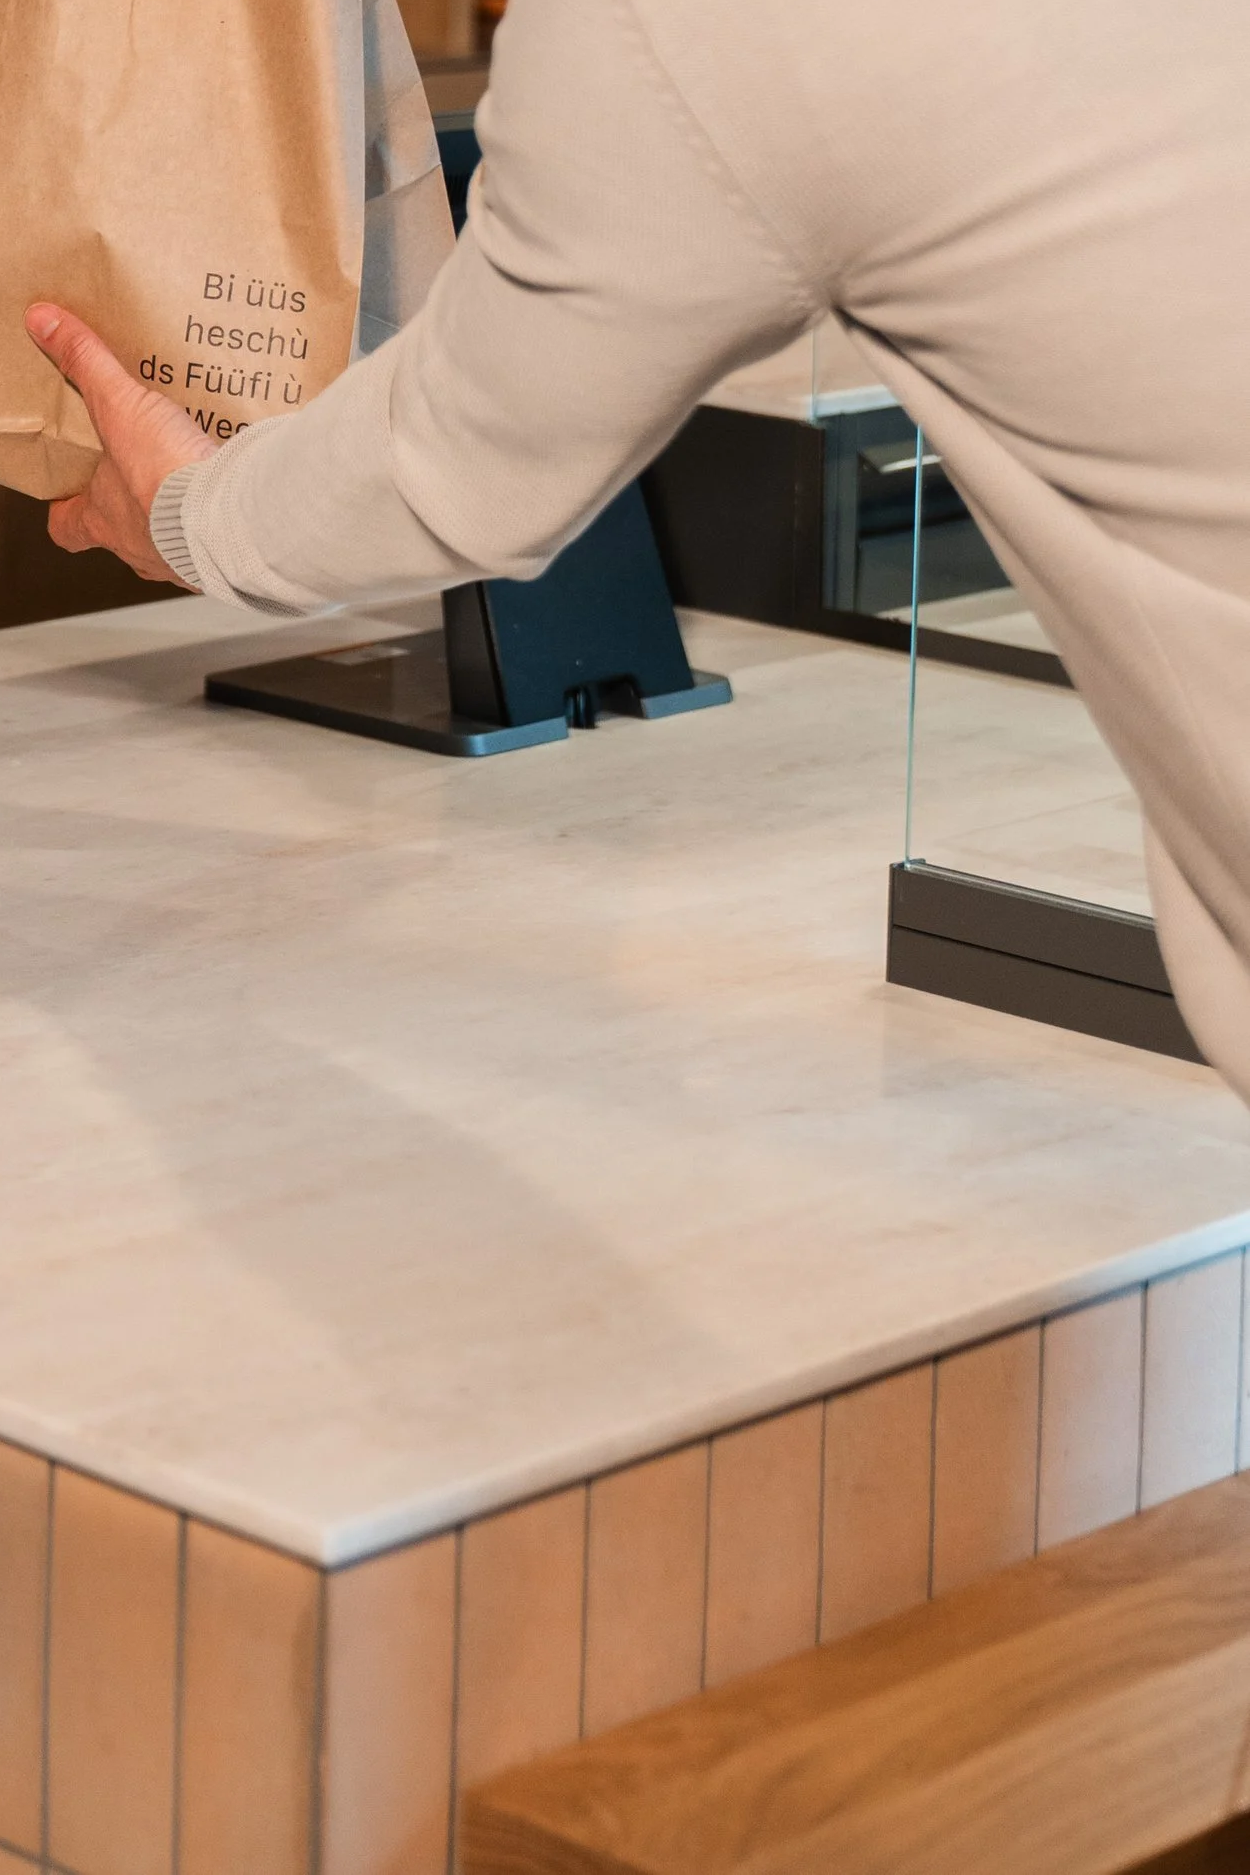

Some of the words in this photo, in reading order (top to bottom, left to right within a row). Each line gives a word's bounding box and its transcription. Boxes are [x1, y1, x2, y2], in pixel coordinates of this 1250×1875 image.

[203, 272, 236, 303] Bi
[245, 278, 307, 314] üüs
[184, 314, 309, 361] heschù
[139, 354, 174, 385] ds
[184, 361, 273, 401] Füüfi
